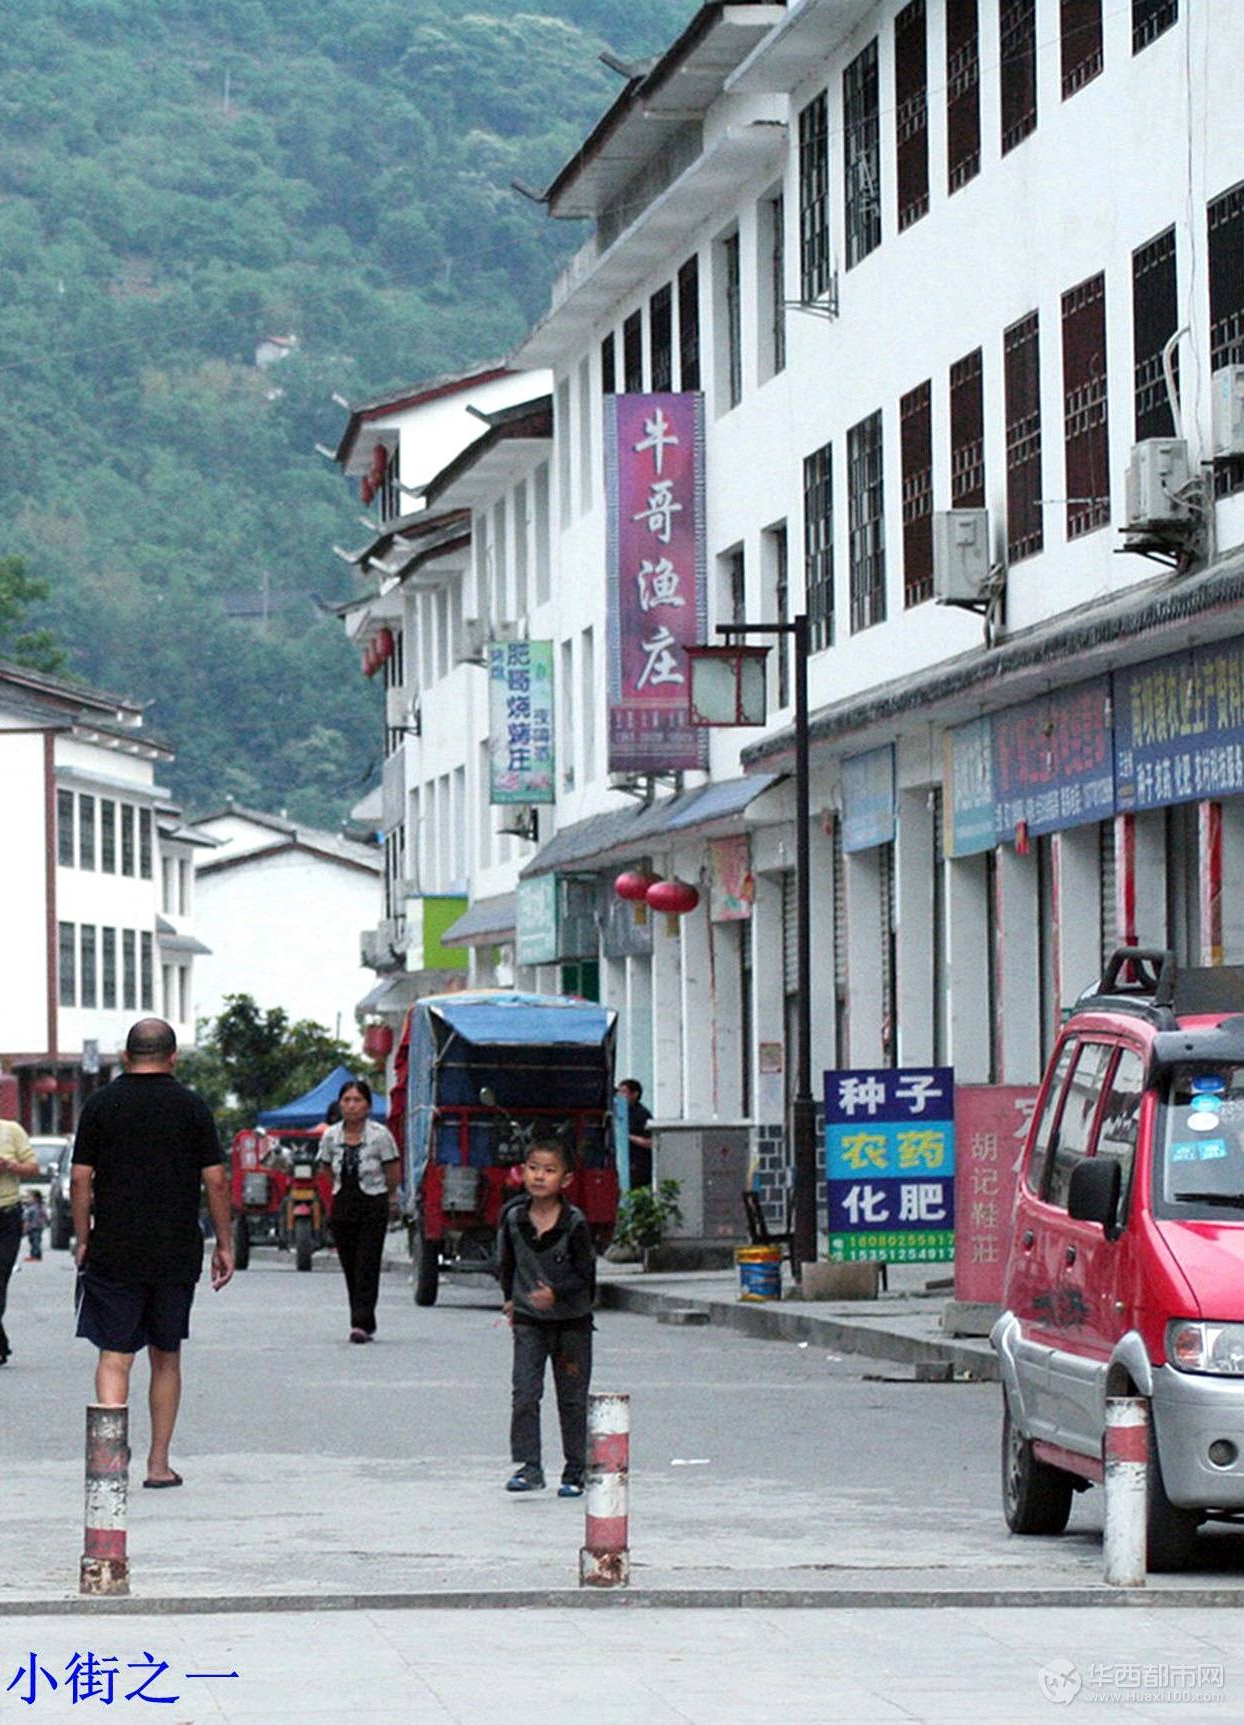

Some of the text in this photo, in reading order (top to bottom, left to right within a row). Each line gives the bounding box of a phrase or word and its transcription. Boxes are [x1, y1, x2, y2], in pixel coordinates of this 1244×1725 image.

[632, 407, 685, 689] 牛哥渔庄
[838, 1075, 943, 1115] 种子
[840, 1130, 946, 1169] 农药
[841, 1183, 946, 1224] 化肥
